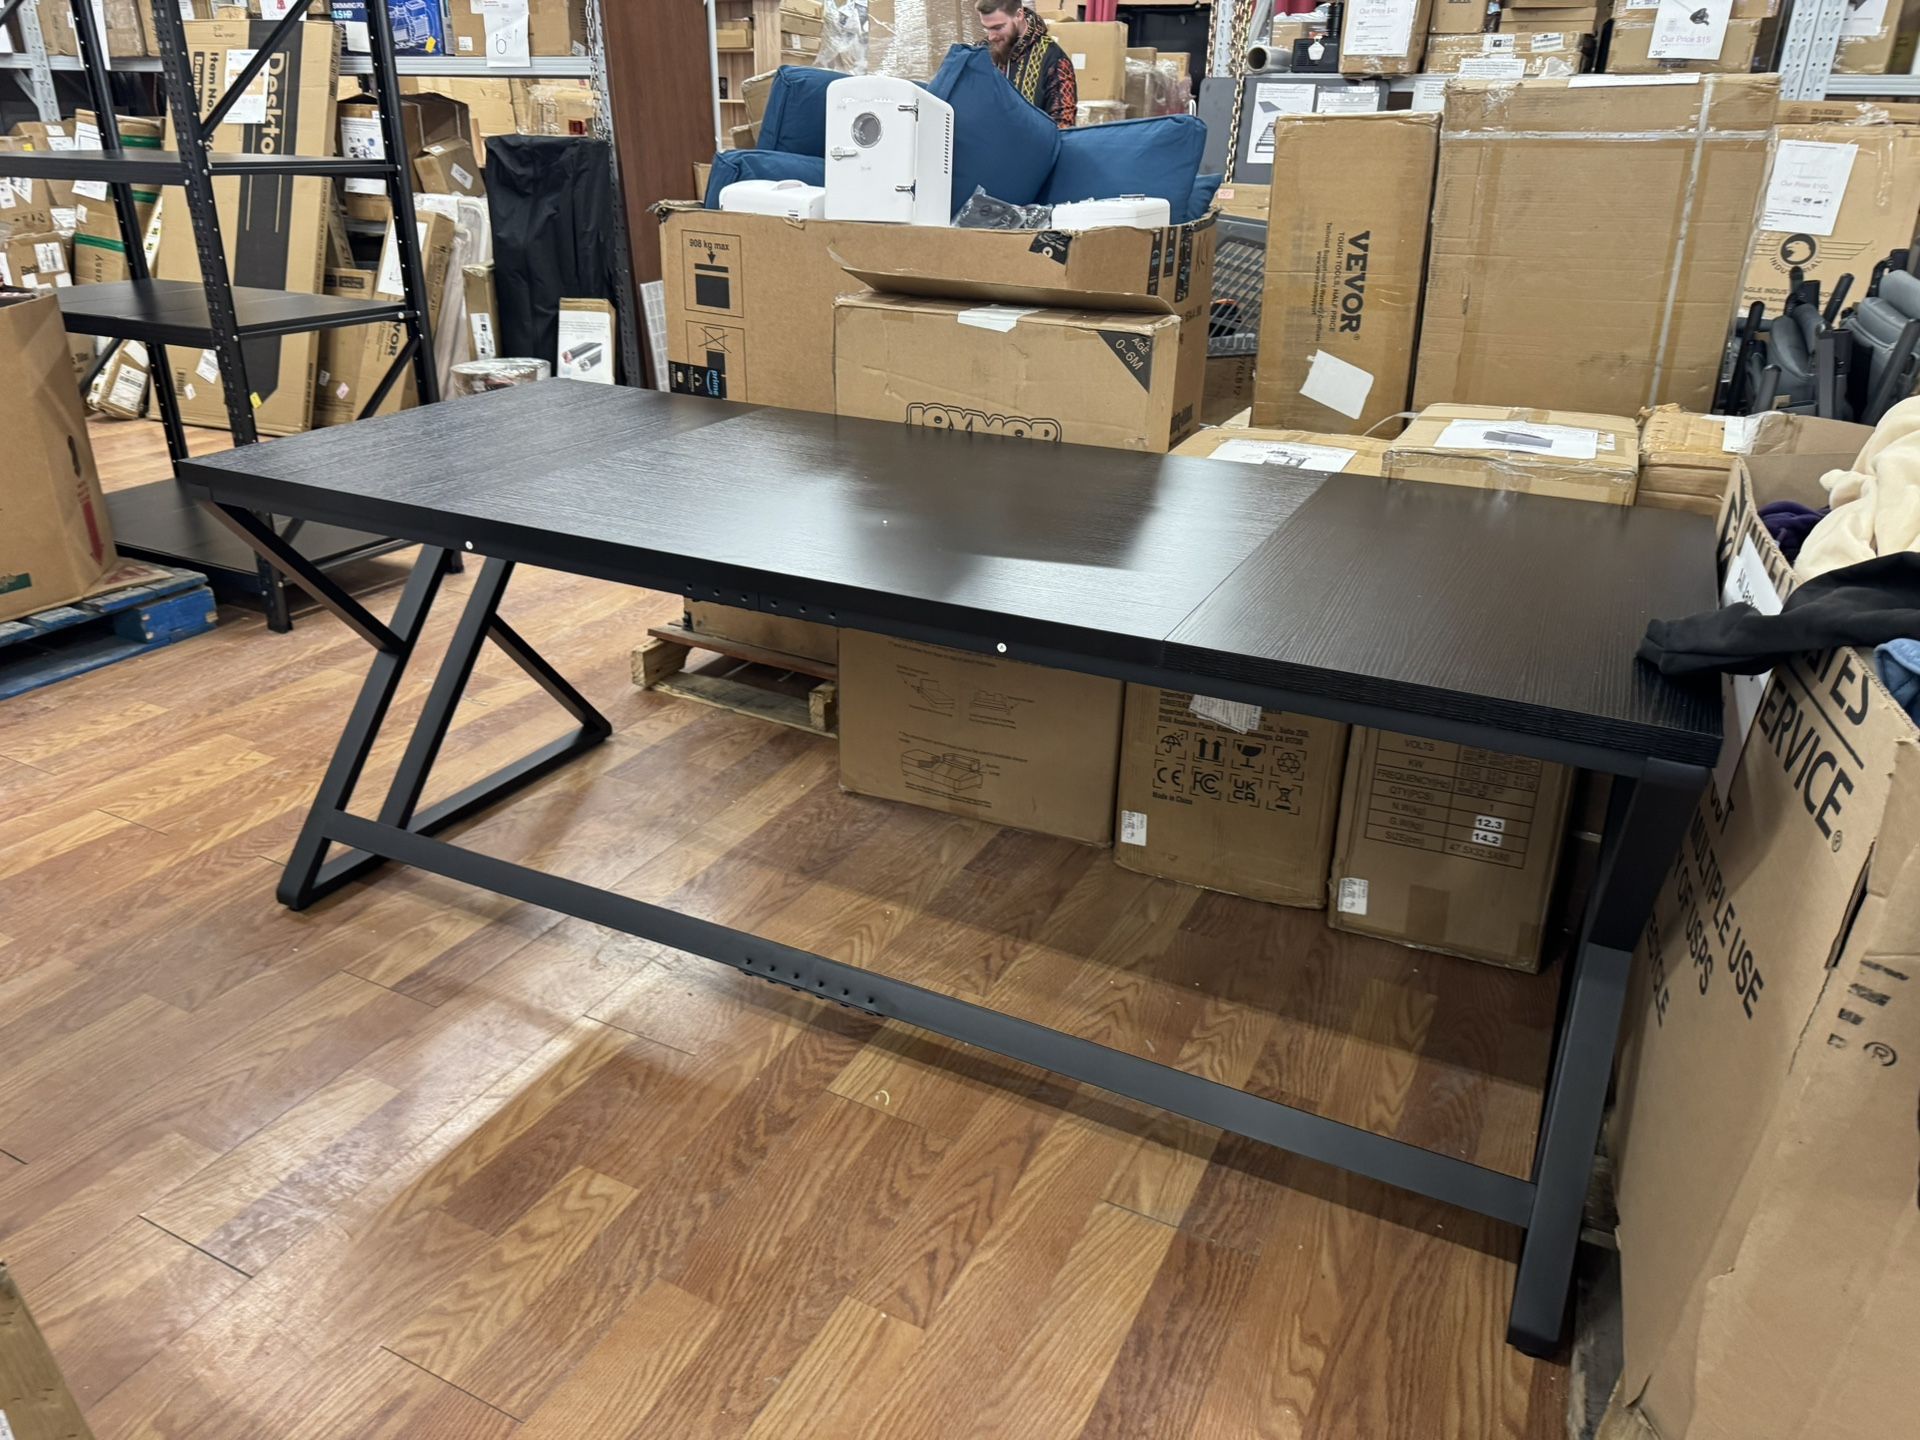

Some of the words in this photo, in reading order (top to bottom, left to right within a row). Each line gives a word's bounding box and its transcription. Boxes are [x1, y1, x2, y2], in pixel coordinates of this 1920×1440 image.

[207, 52, 219, 85] Item
[260, 53, 285, 154] Deskto
[689, 238, 702, 249] 908
[703, 240, 713, 251] kg
[713, 242, 730, 251] max
[1335, 231, 1345, 260] TOUGH
[1339, 230, 1371, 333] VEVOR
[1328, 310, 1338, 332] PRICE
[1131, 338, 1150, 356] AGE
[711, 369, 720, 397] prime
[1404, 739, 1435, 752] VOLTS
[1758, 676, 1855, 840] ERVICE
[1476, 817, 1503, 830] 12.3
[1473, 832, 1500, 845] 14.2
[1686, 902, 1714, 996] USPS
[1728, 926, 1764, 1020] USE
